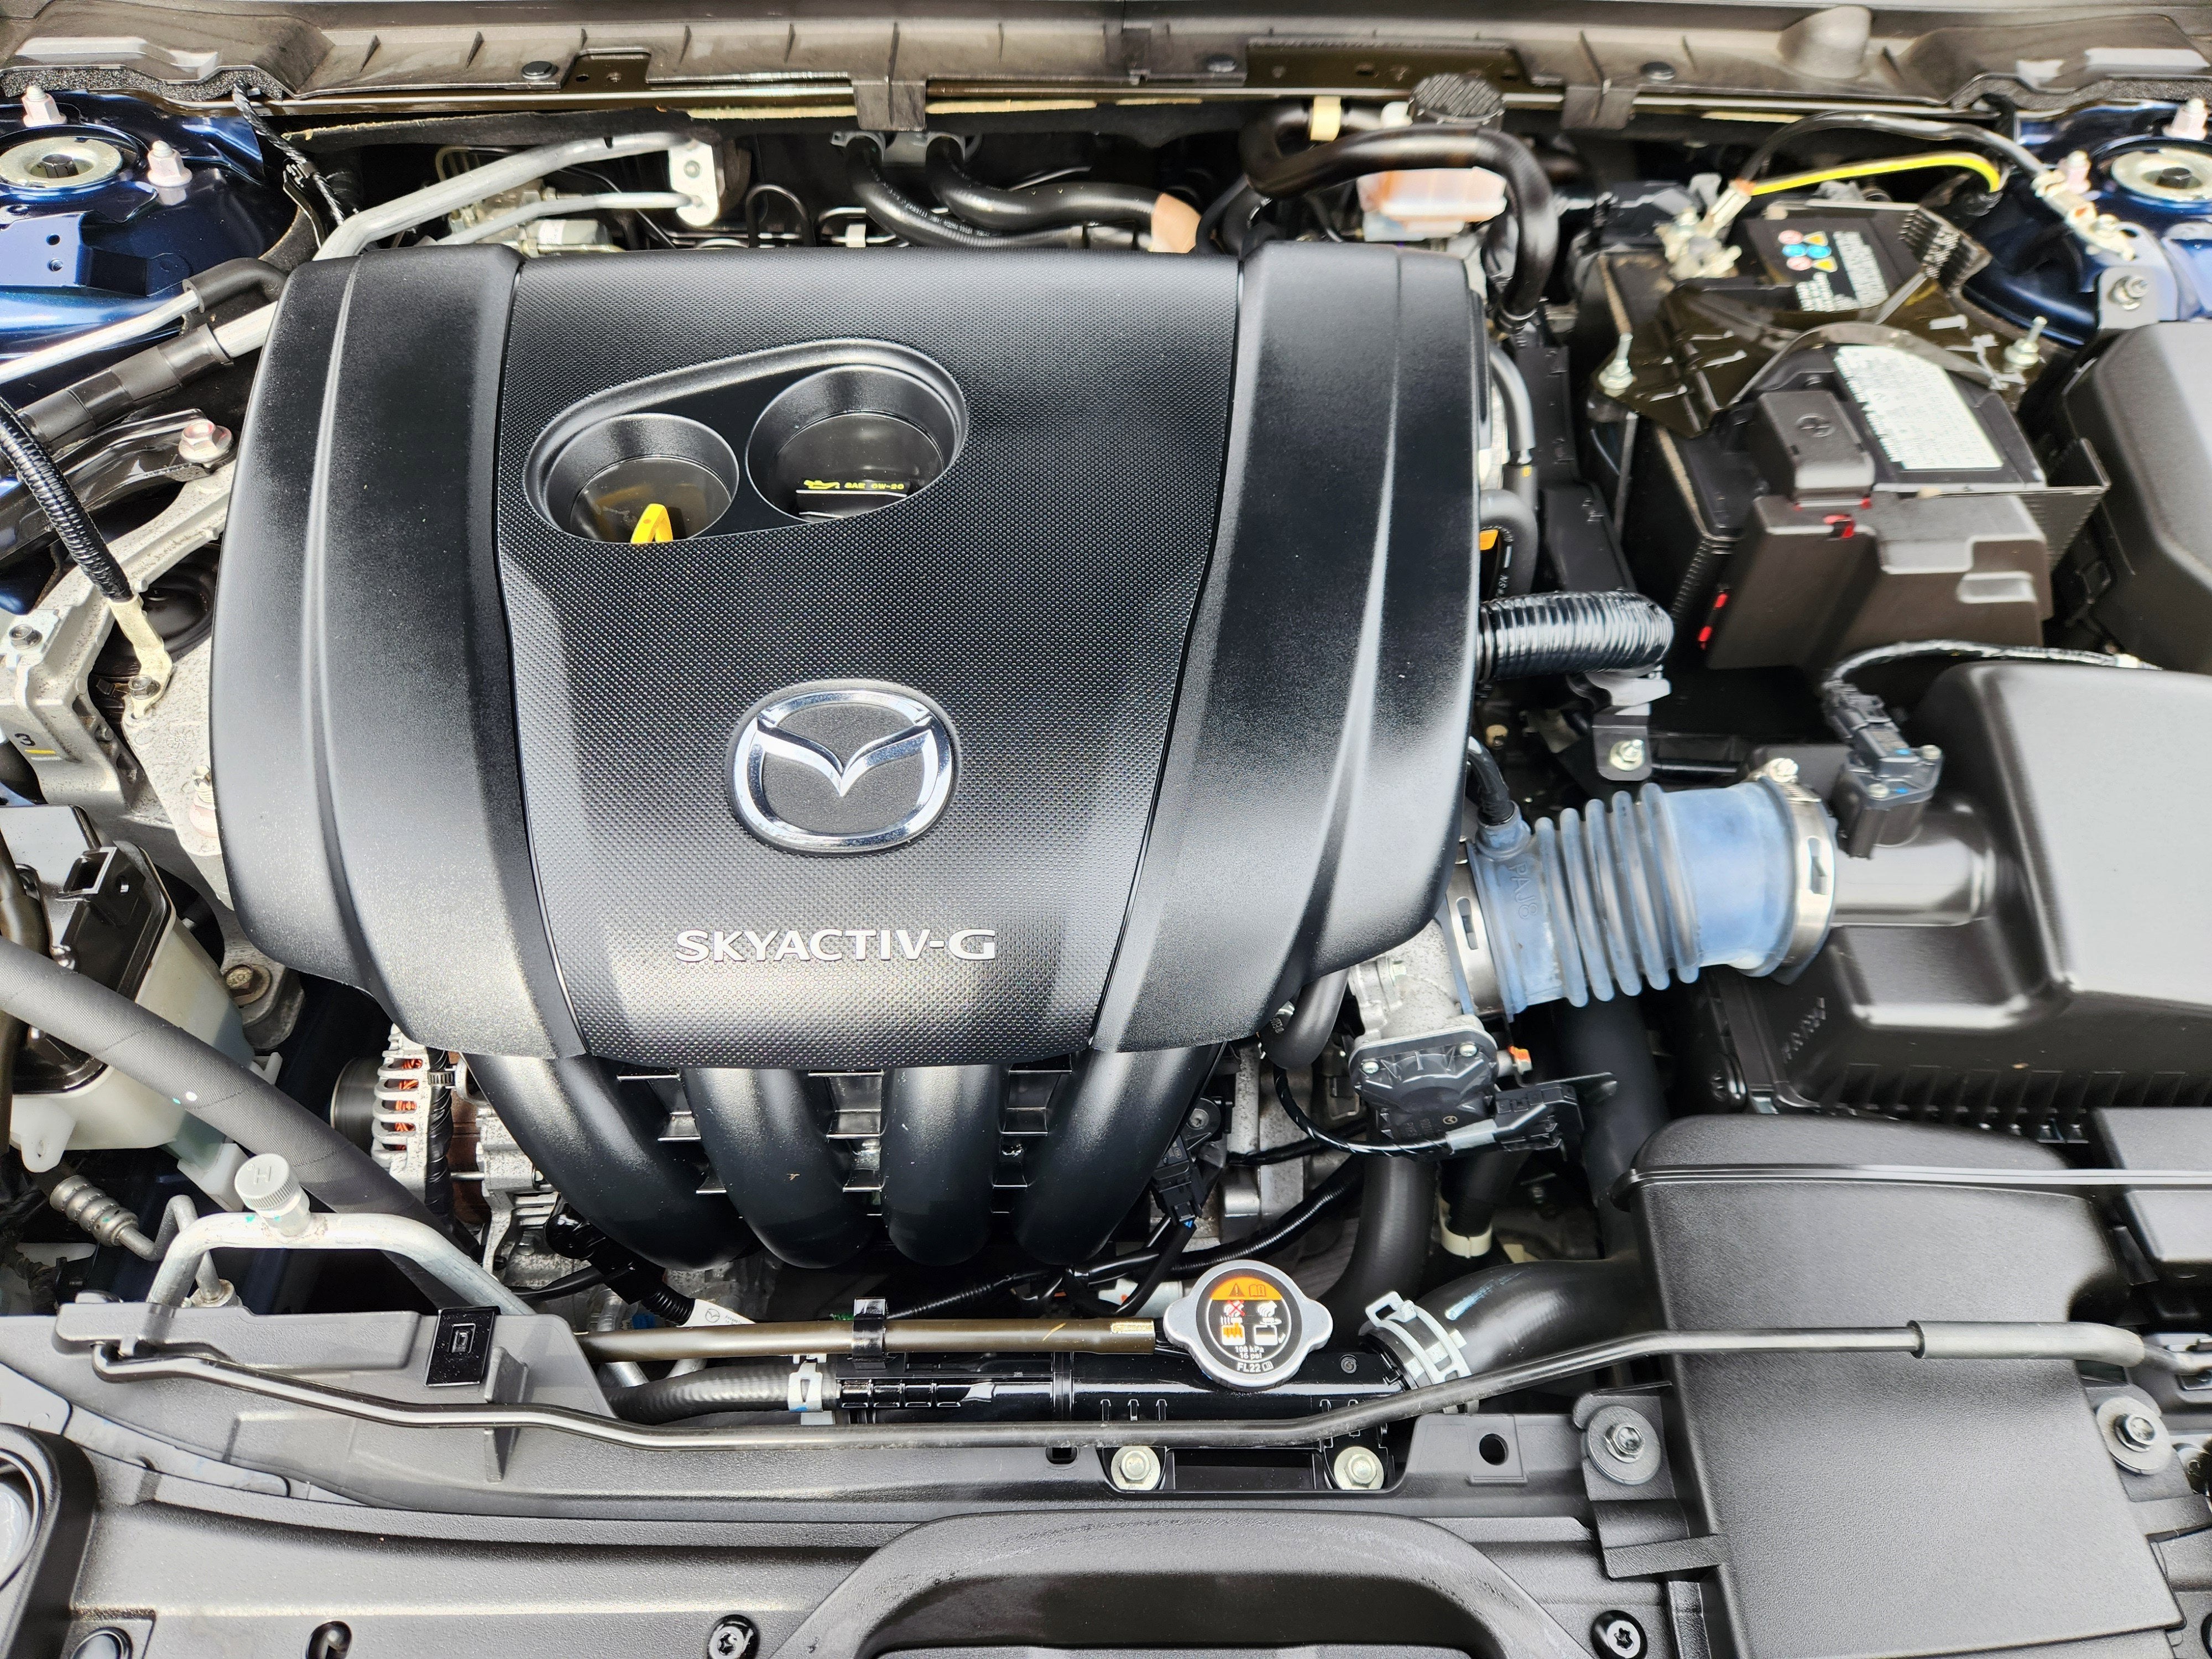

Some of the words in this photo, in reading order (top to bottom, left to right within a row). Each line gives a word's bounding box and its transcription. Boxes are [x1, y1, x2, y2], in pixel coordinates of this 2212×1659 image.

[14, 733, 36, 747] 3
[1508, 862, 1538, 920] PAJ8
[675, 928, 997, 962] SKYACTIV-G
[254, 1166, 272, 1185] H
[1249, 1345, 1264, 1353] kPa
[1237, 1362, 1261, 1373] FL22
